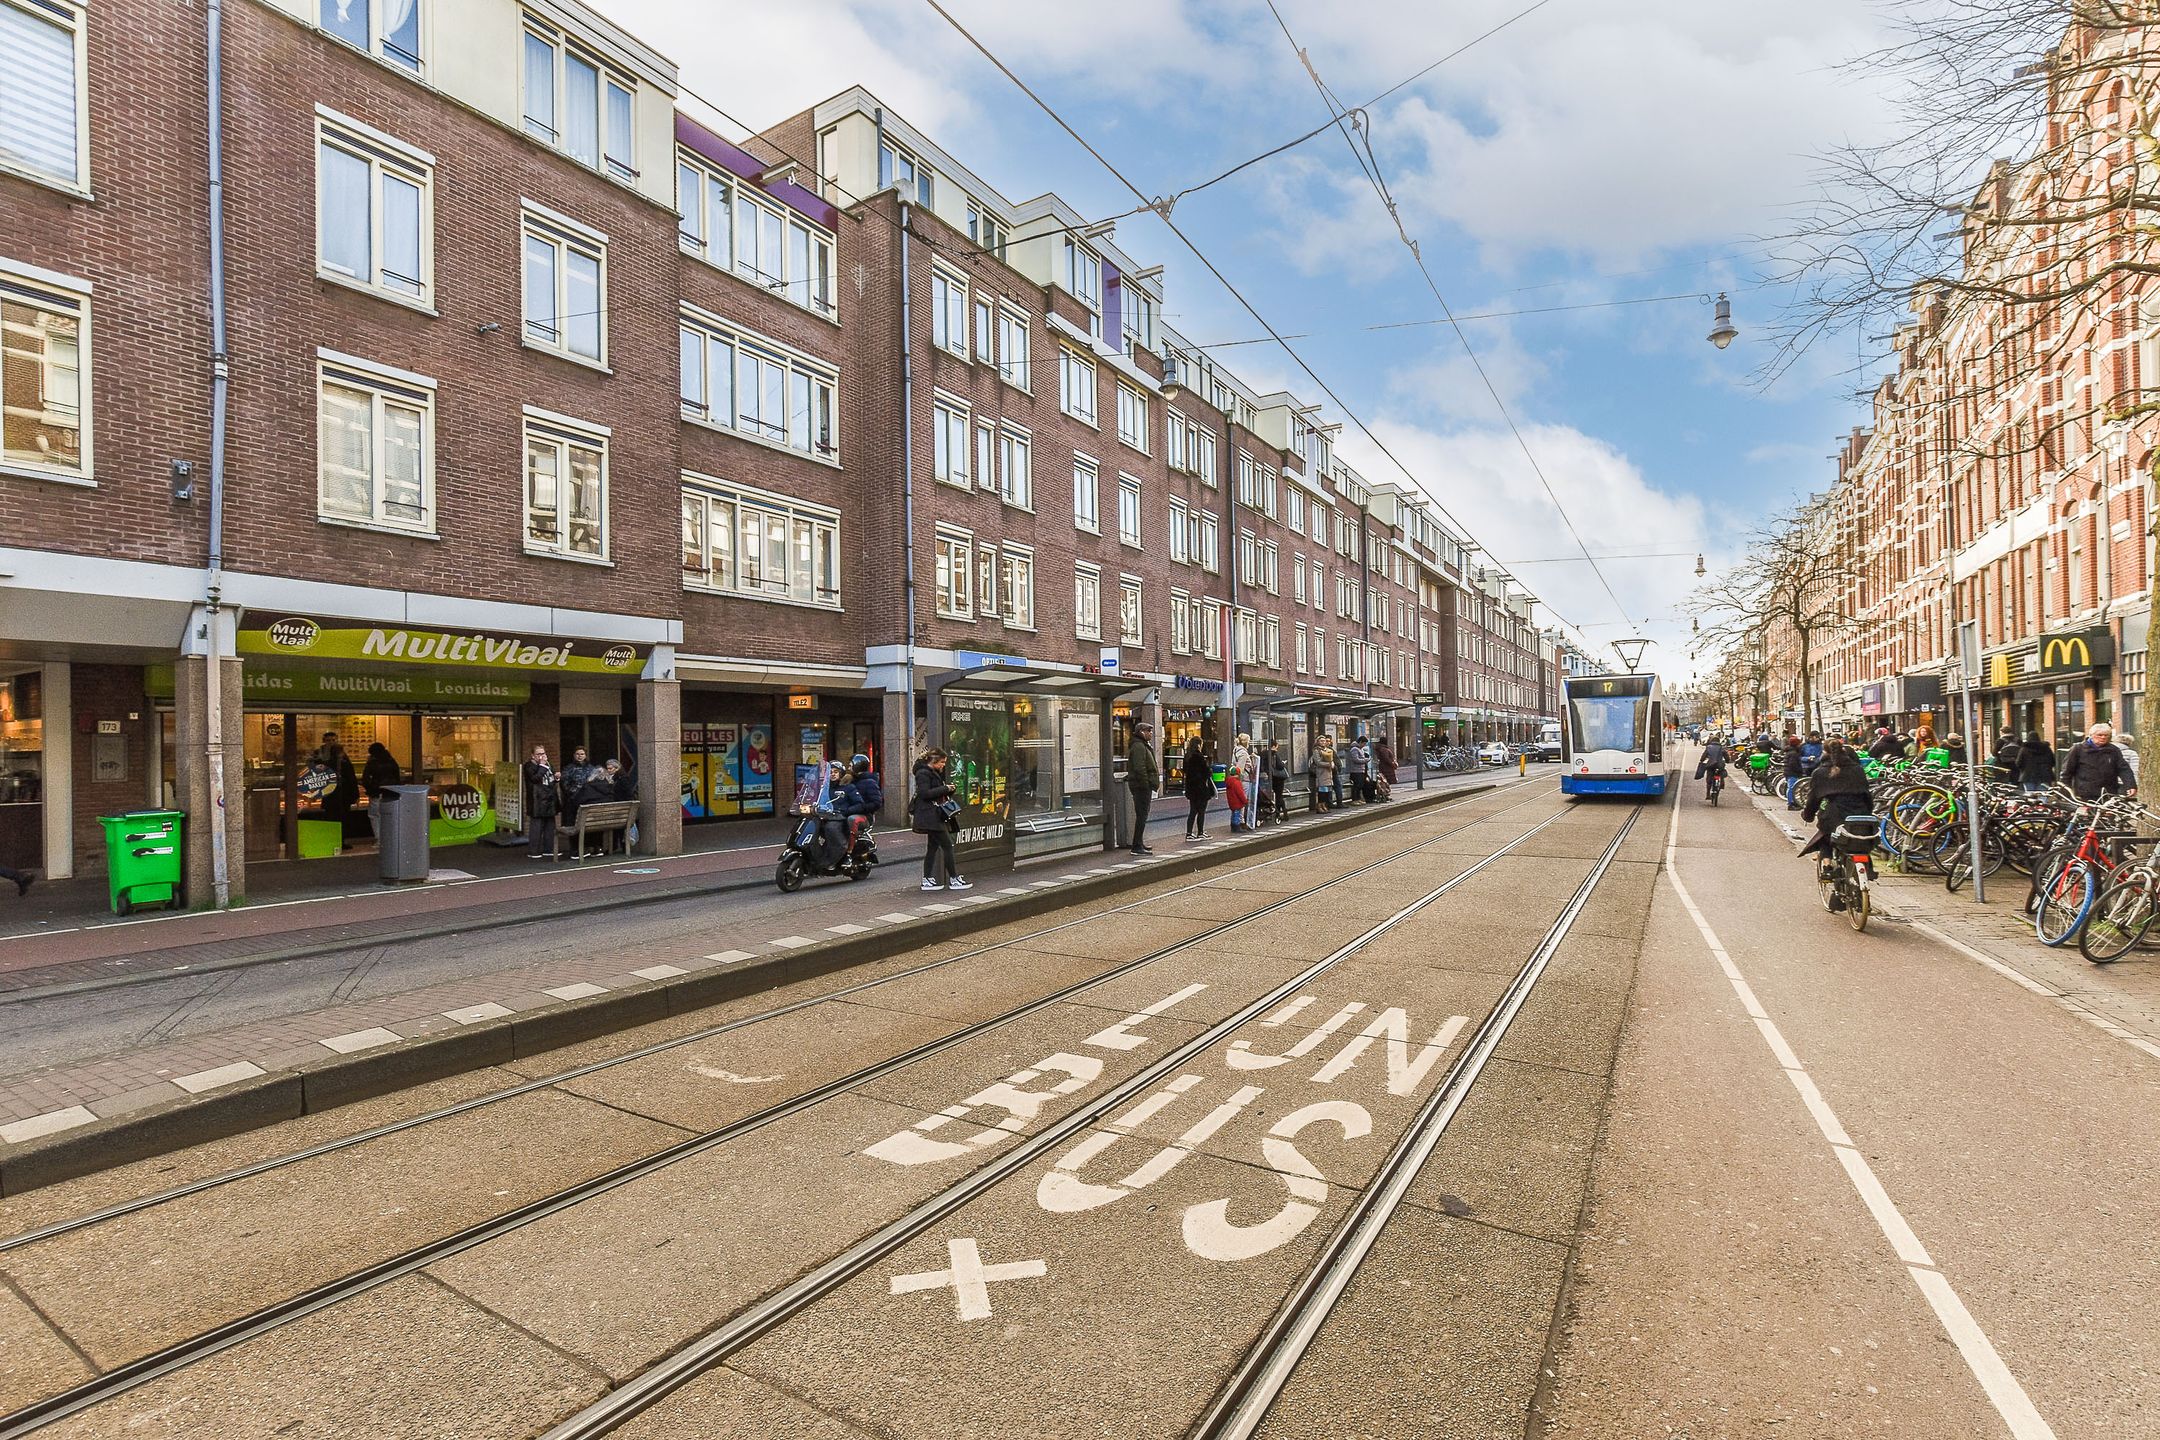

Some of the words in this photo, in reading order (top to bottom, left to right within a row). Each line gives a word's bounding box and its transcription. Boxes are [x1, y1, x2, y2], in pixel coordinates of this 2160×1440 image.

[272, 623, 317, 637] Multi
[272, 634, 312, 647] Vlaai
[362, 629, 574, 667] MultiVlaai
[607, 649, 634, 660] Multi
[604, 657, 630, 667] Vlaai
[319, 676, 412, 693] MultiVlaai
[434, 680, 509, 697] Leonidas
[1602, 682, 1613, 693] 17
[102, 722, 117, 732] 173
[683, 731, 734, 742] EOPLES
[303, 774, 329, 784] AMERICAN
[308, 780, 327, 789] BAKERY
[443, 791, 484, 806] Multi
[445, 806, 482, 821] Vlaai
[956, 827, 971, 844] NEW
[972, 826, 985, 842] AXE
[986, 824, 1004, 840] WILD
